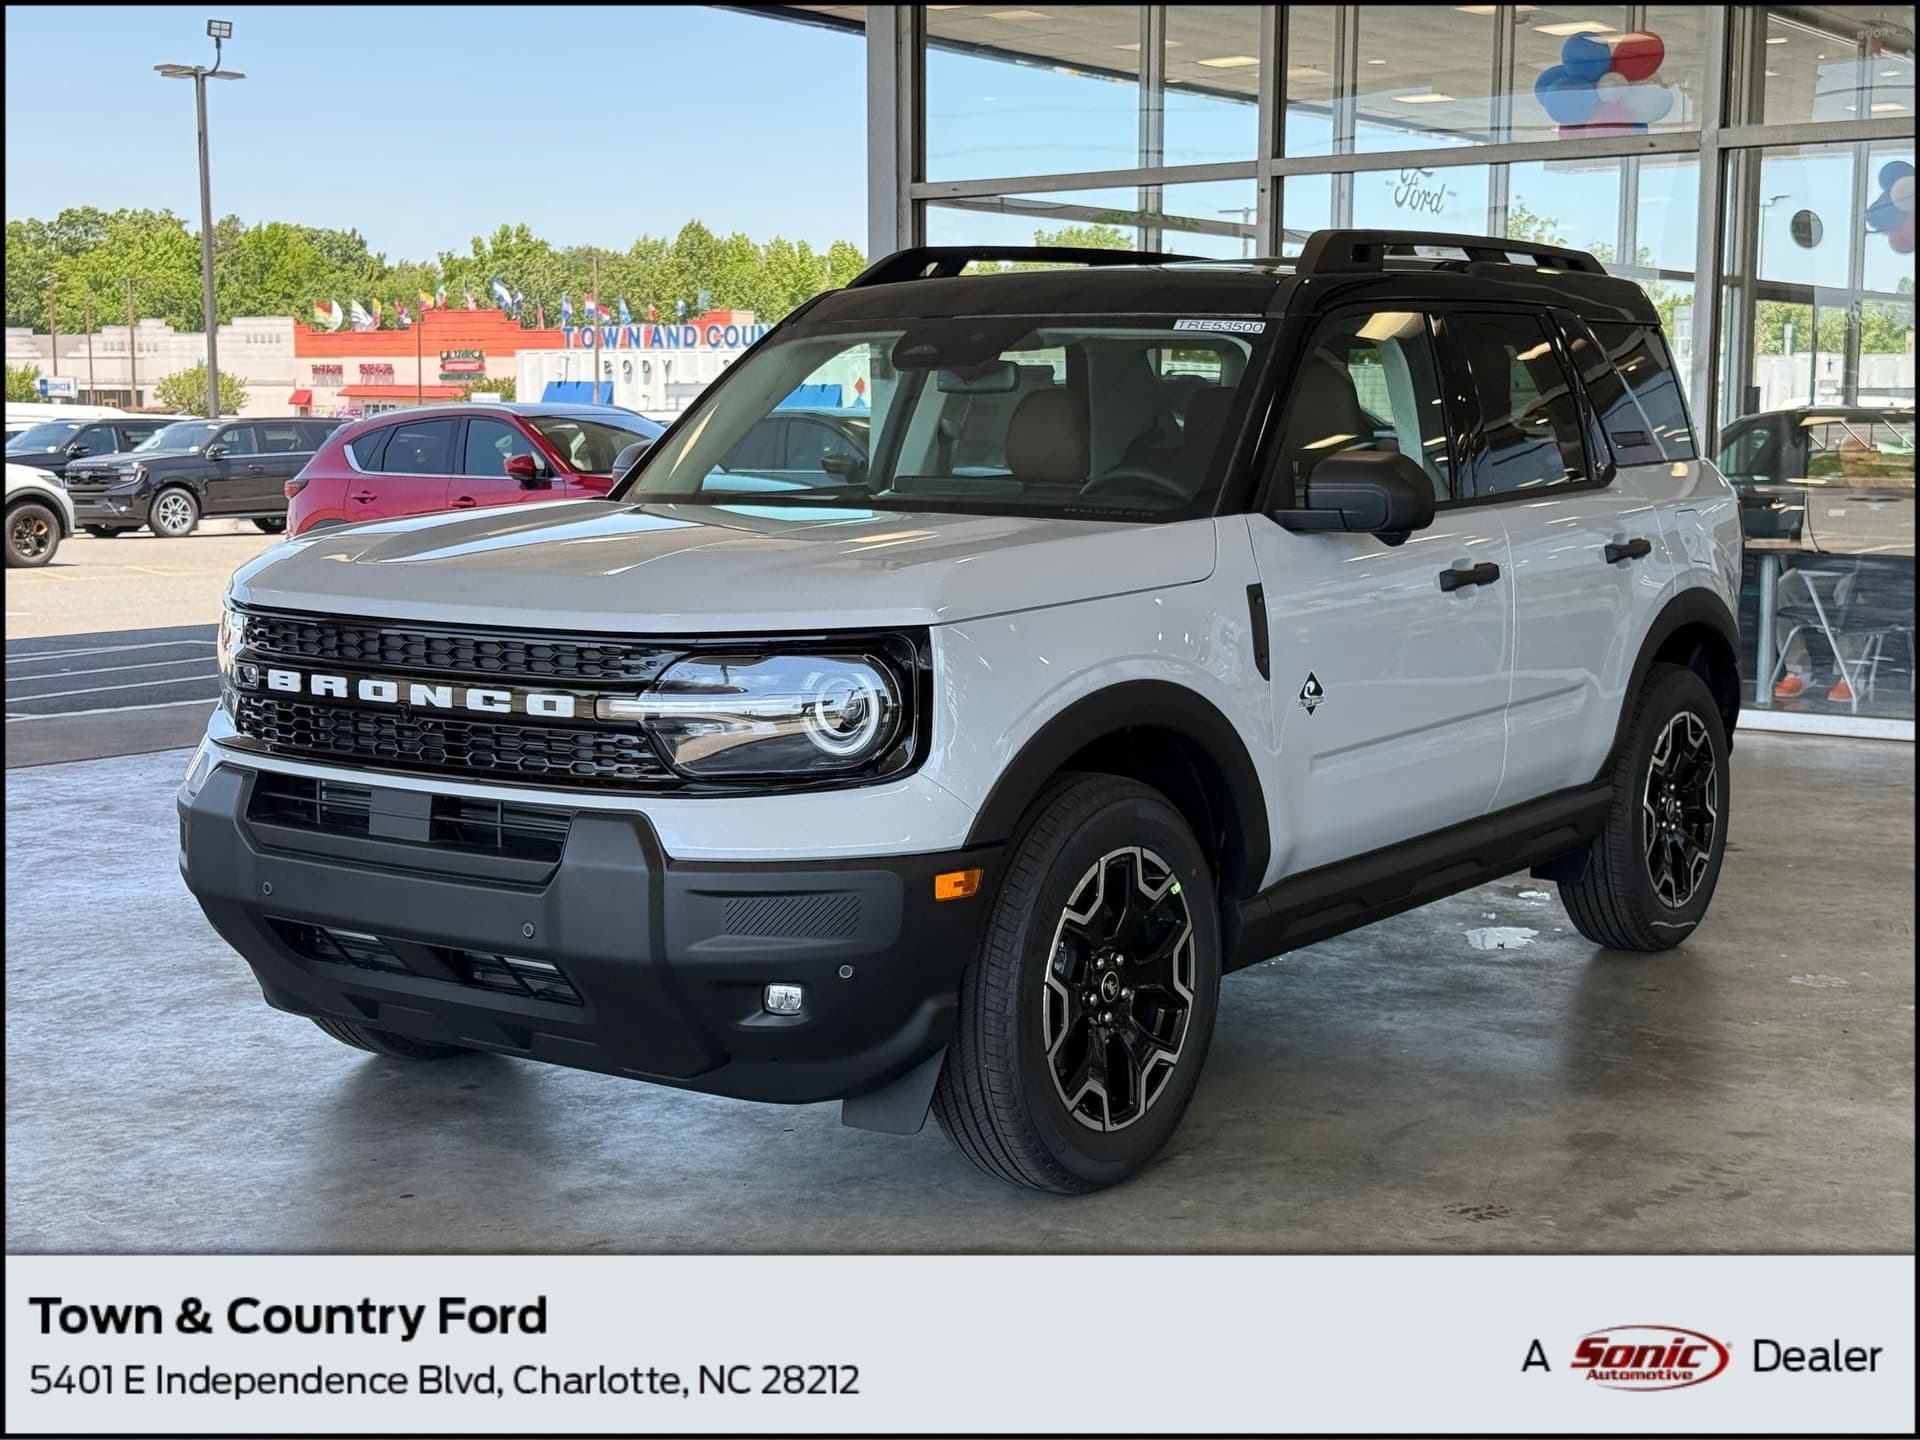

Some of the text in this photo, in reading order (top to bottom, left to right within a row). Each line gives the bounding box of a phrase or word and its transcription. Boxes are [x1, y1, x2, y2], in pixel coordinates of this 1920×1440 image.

[1394, 168, 1446, 214] Ford
[562, 326, 641, 349] TOWN
[650, 326, 698, 349] AND
[1179, 320, 1263, 333] TRE53500
[603, 360, 672, 376] BODY
[268, 668, 576, 718] BRONCO
